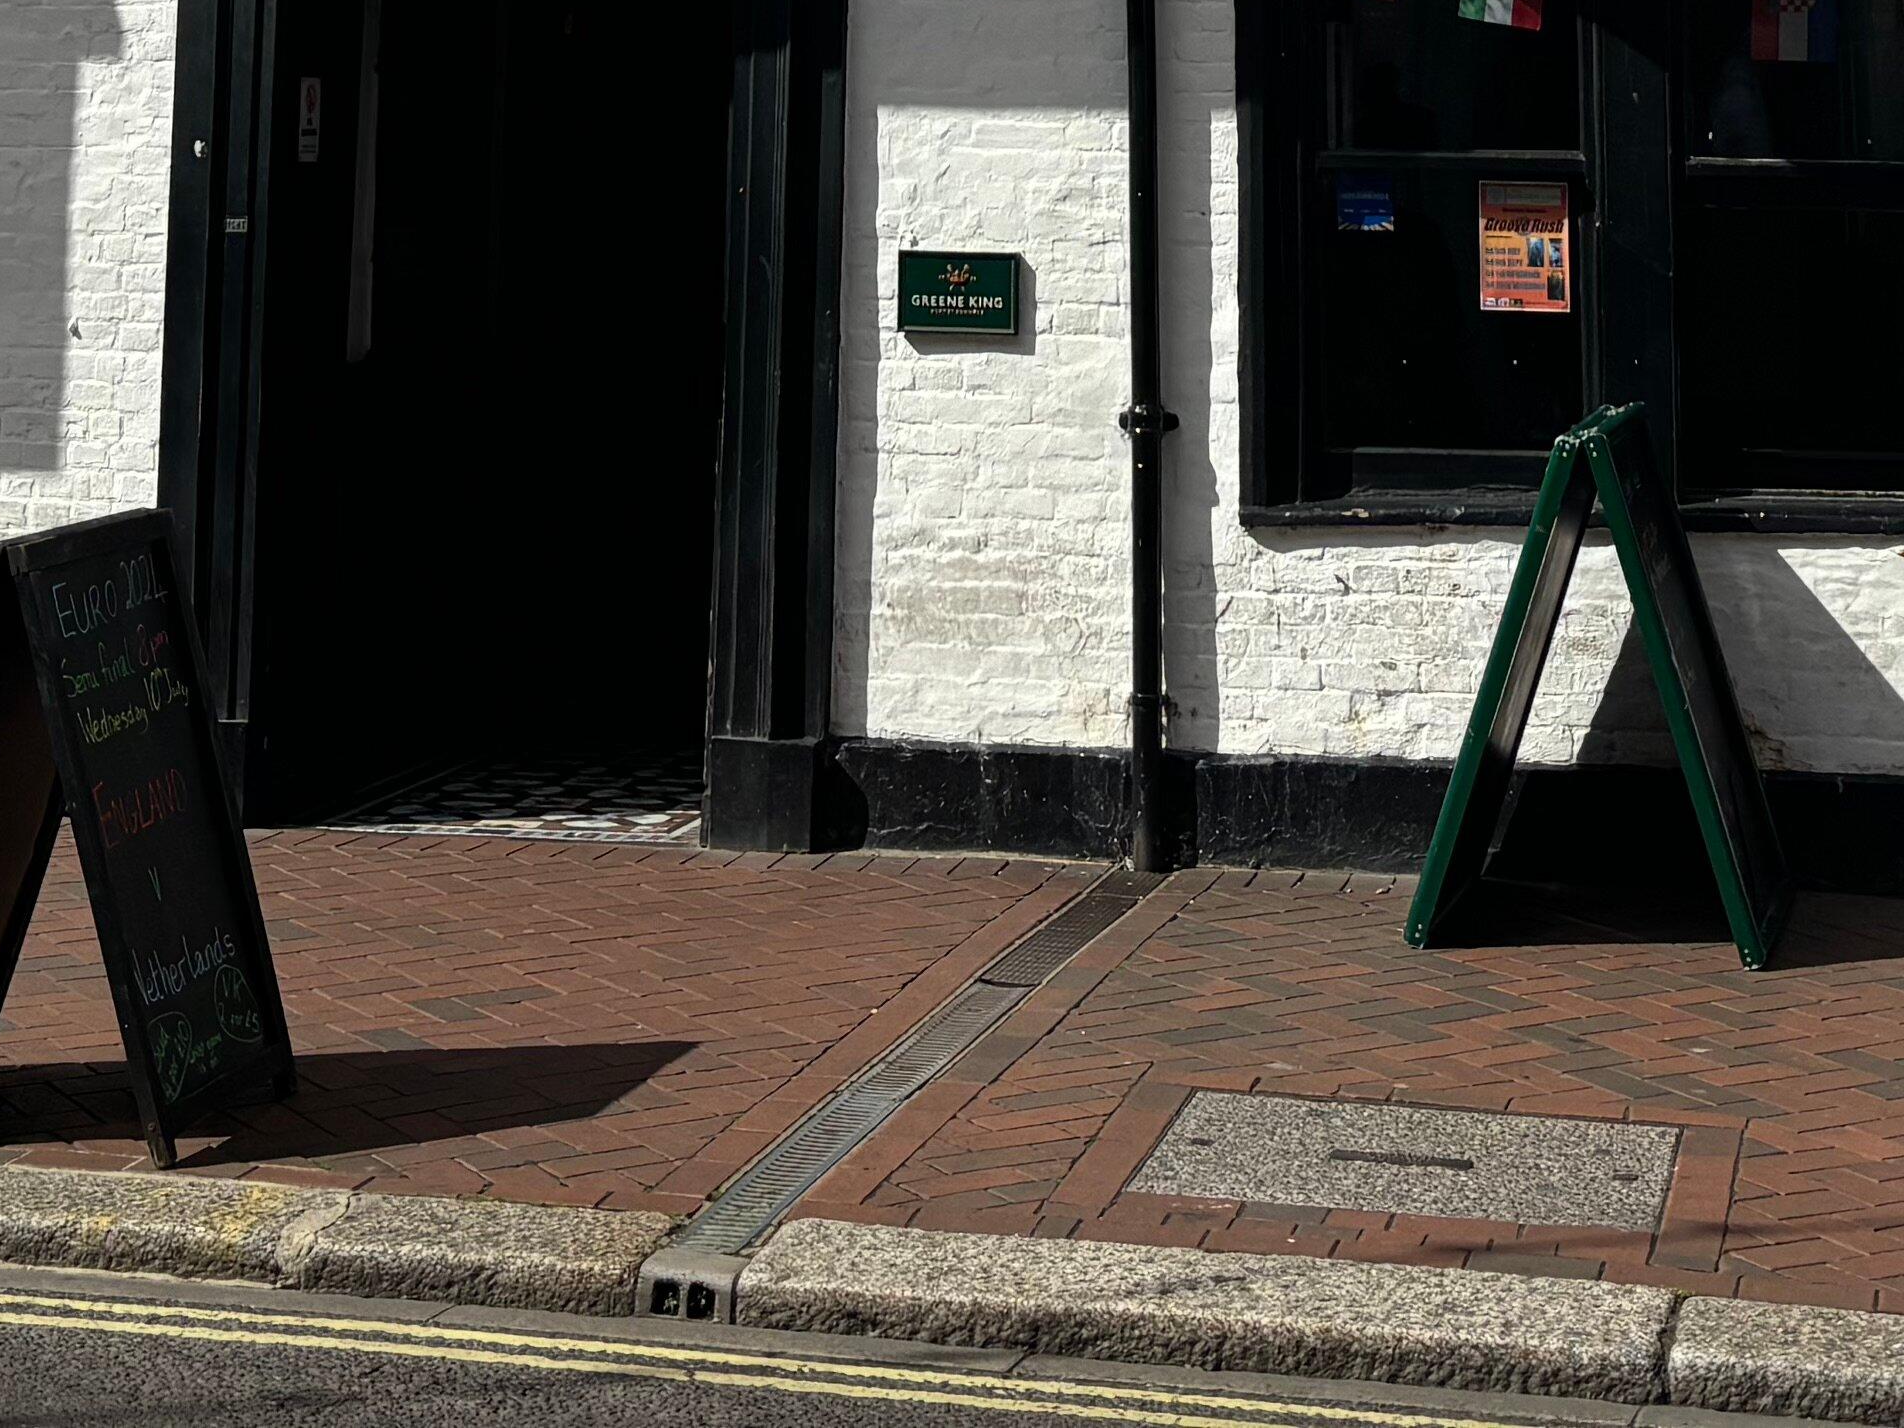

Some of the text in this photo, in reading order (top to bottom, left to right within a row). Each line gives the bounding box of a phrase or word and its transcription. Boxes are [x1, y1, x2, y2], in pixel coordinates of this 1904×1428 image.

[911, 294, 1003, 309] GREENE KING
[52, 579, 117, 639] EURO
[76, 703, 149, 744] Wednesday
[92, 768, 187, 849] ENGLAND
[131, 926, 236, 1006] Netherlands
